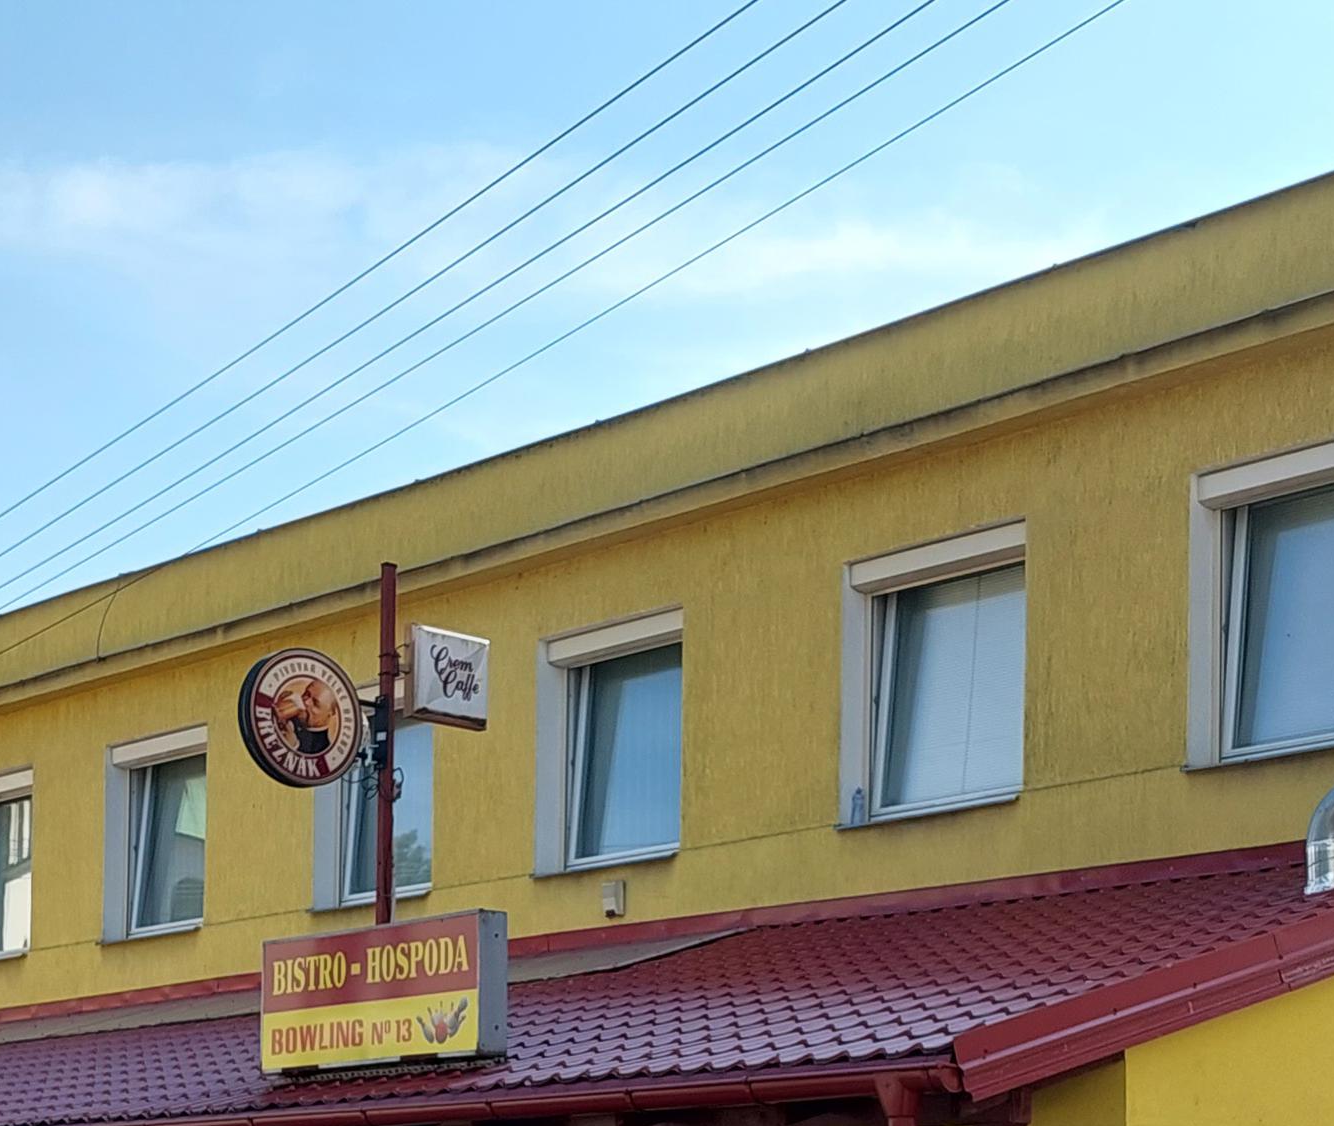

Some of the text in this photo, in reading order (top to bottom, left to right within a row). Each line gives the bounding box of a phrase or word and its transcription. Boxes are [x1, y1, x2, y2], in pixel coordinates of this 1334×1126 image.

[272, 951, 347, 996] BISTRO
[366, 934, 470, 984] HOSPODA
[271, 1018, 364, 1056] BOWLING
[395, 1018, 412, 1043] 13
